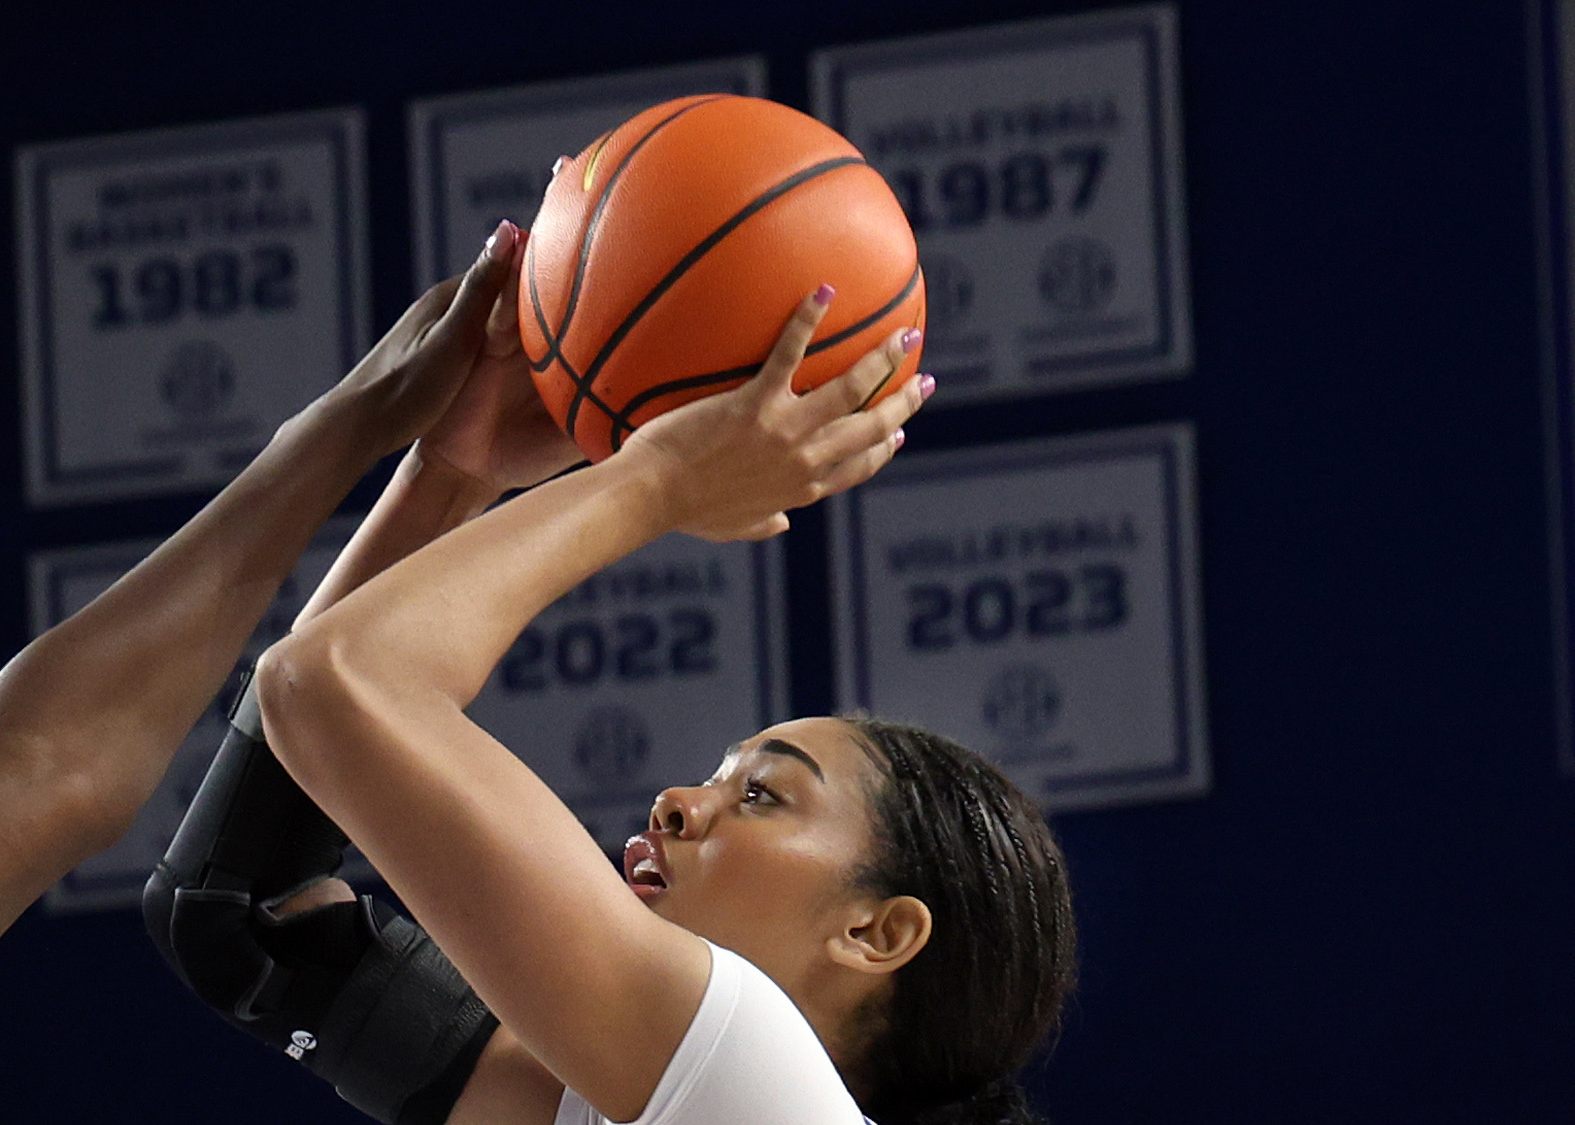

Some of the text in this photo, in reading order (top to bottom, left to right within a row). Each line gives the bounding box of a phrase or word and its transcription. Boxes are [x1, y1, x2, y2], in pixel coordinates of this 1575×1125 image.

[869, 95, 1119, 153] VOLLEYBALL
[894, 144, 1107, 232] 1987
[90, 244, 298, 331] 1982
[552, 560, 726, 607] EYBALL
[889, 513, 1138, 571] VOLLEYBALL
[906, 563, 1130, 650] 2023
[500, 606, 718, 696] 2022
